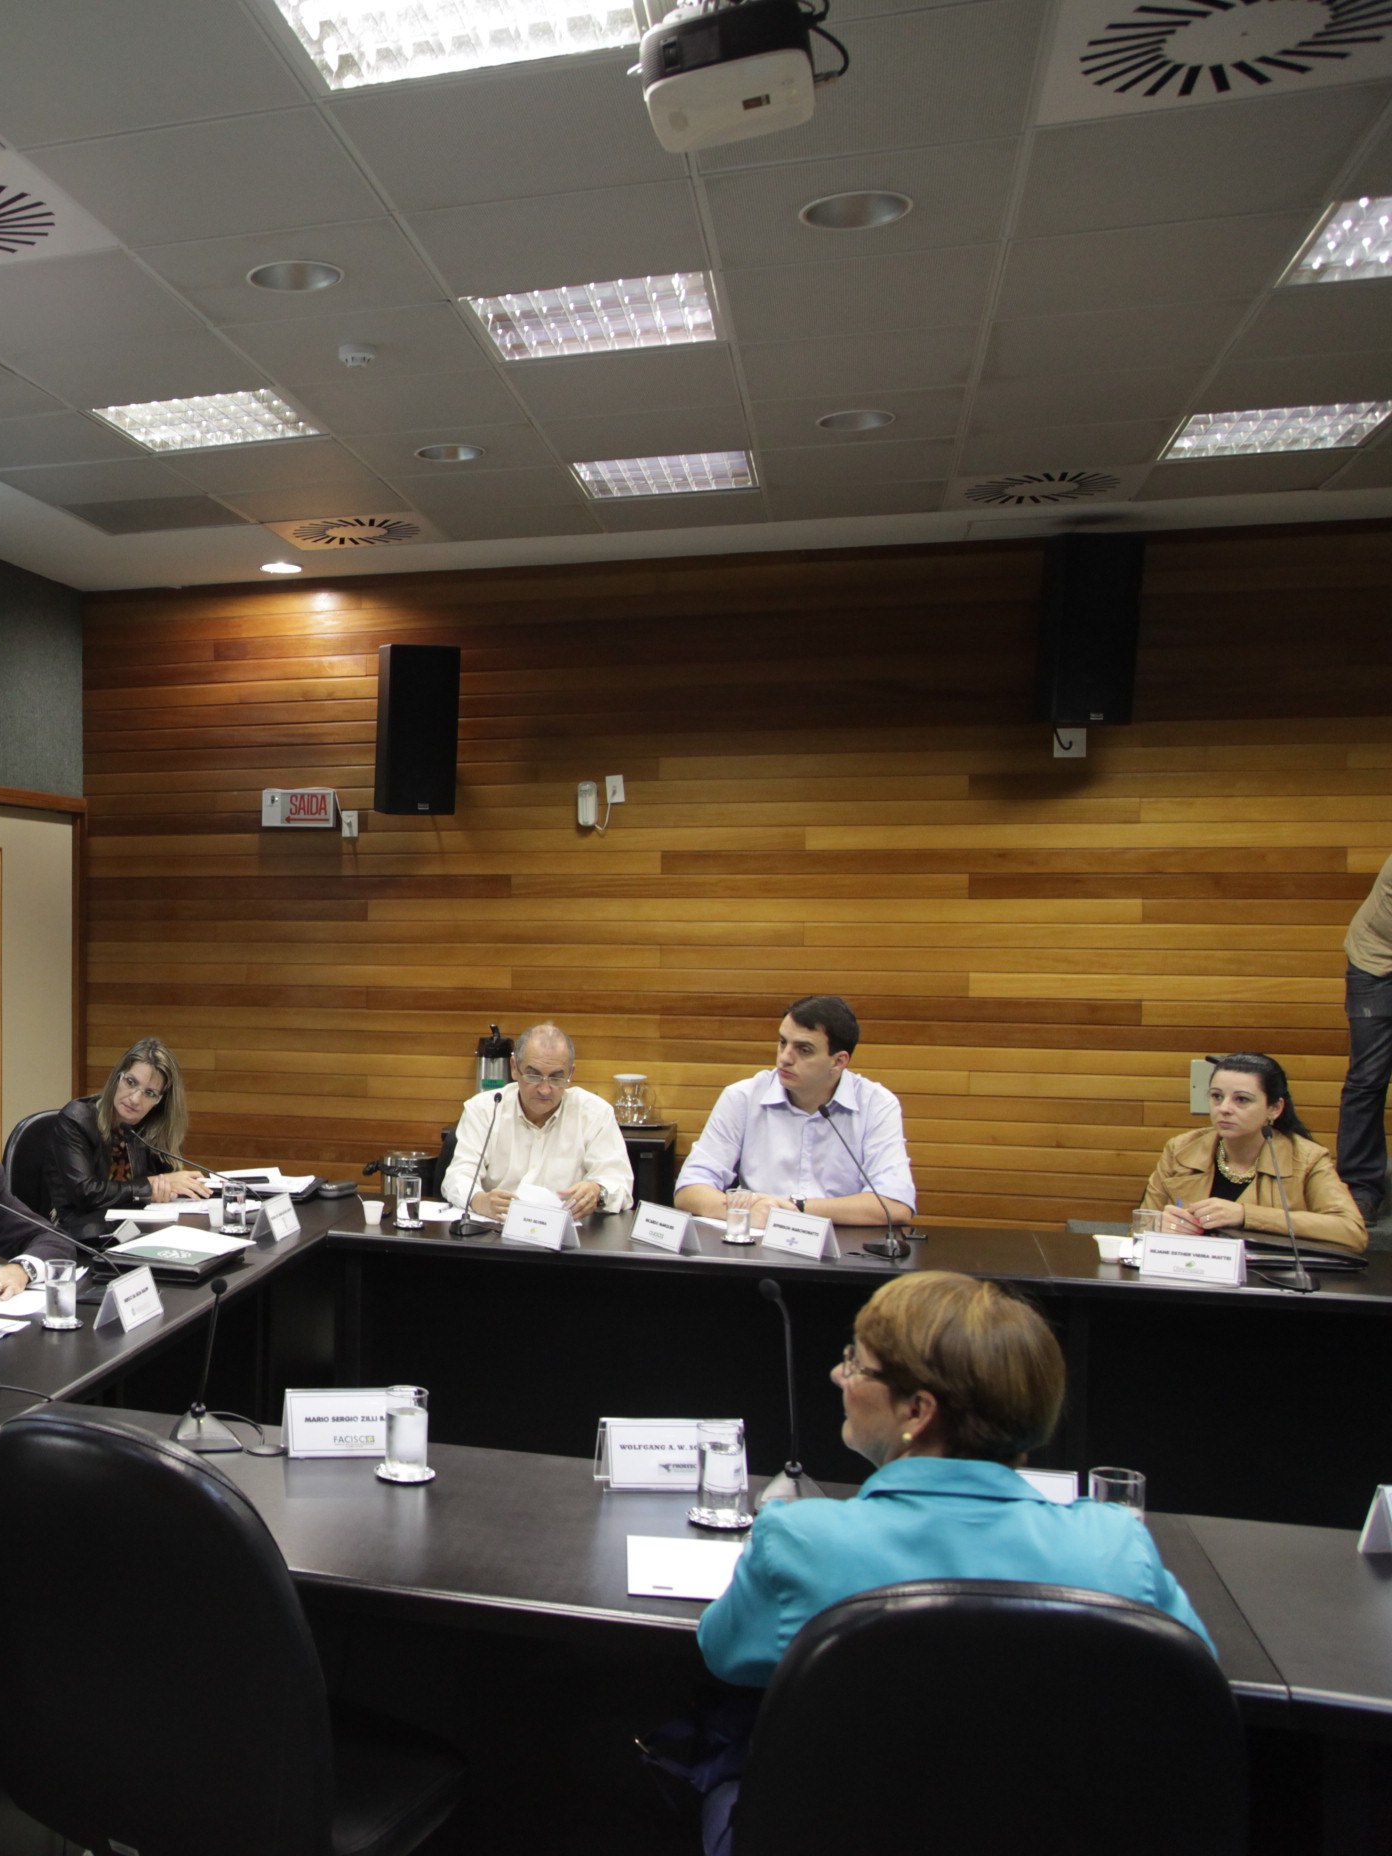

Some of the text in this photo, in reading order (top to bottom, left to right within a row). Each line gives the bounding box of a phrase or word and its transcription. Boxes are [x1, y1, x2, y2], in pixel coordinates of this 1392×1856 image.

[304, 1415, 330, 1424] MARIO
[331, 1414, 359, 1423] SERGIO
[360, 1414, 378, 1423] ZILLI
[333, 1434, 368, 1444] FACISC
[619, 1443, 667, 1451] WOLFGANG
